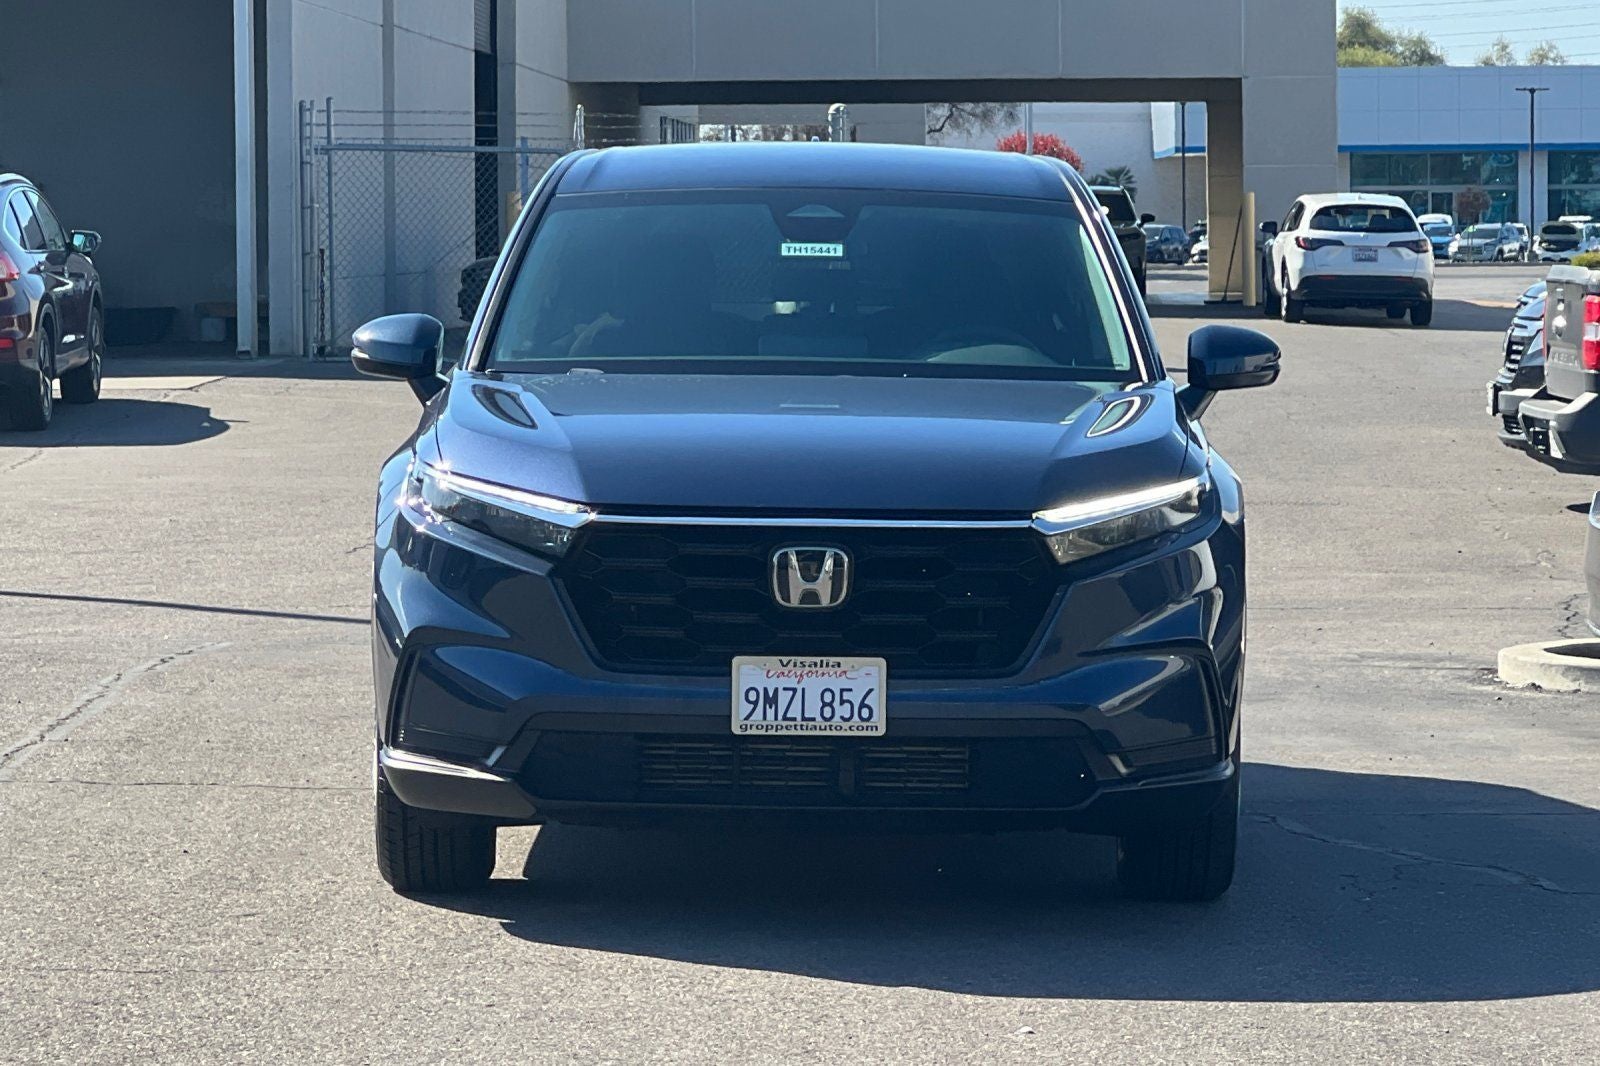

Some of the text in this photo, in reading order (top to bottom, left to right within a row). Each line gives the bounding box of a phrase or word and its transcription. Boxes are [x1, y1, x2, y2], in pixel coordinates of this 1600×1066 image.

[785, 246, 838, 254] TH15441
[778, 658, 842, 669] Visalia
[743, 686, 875, 723] 9MZL856
[739, 722, 879, 733] groppettiauto.com
